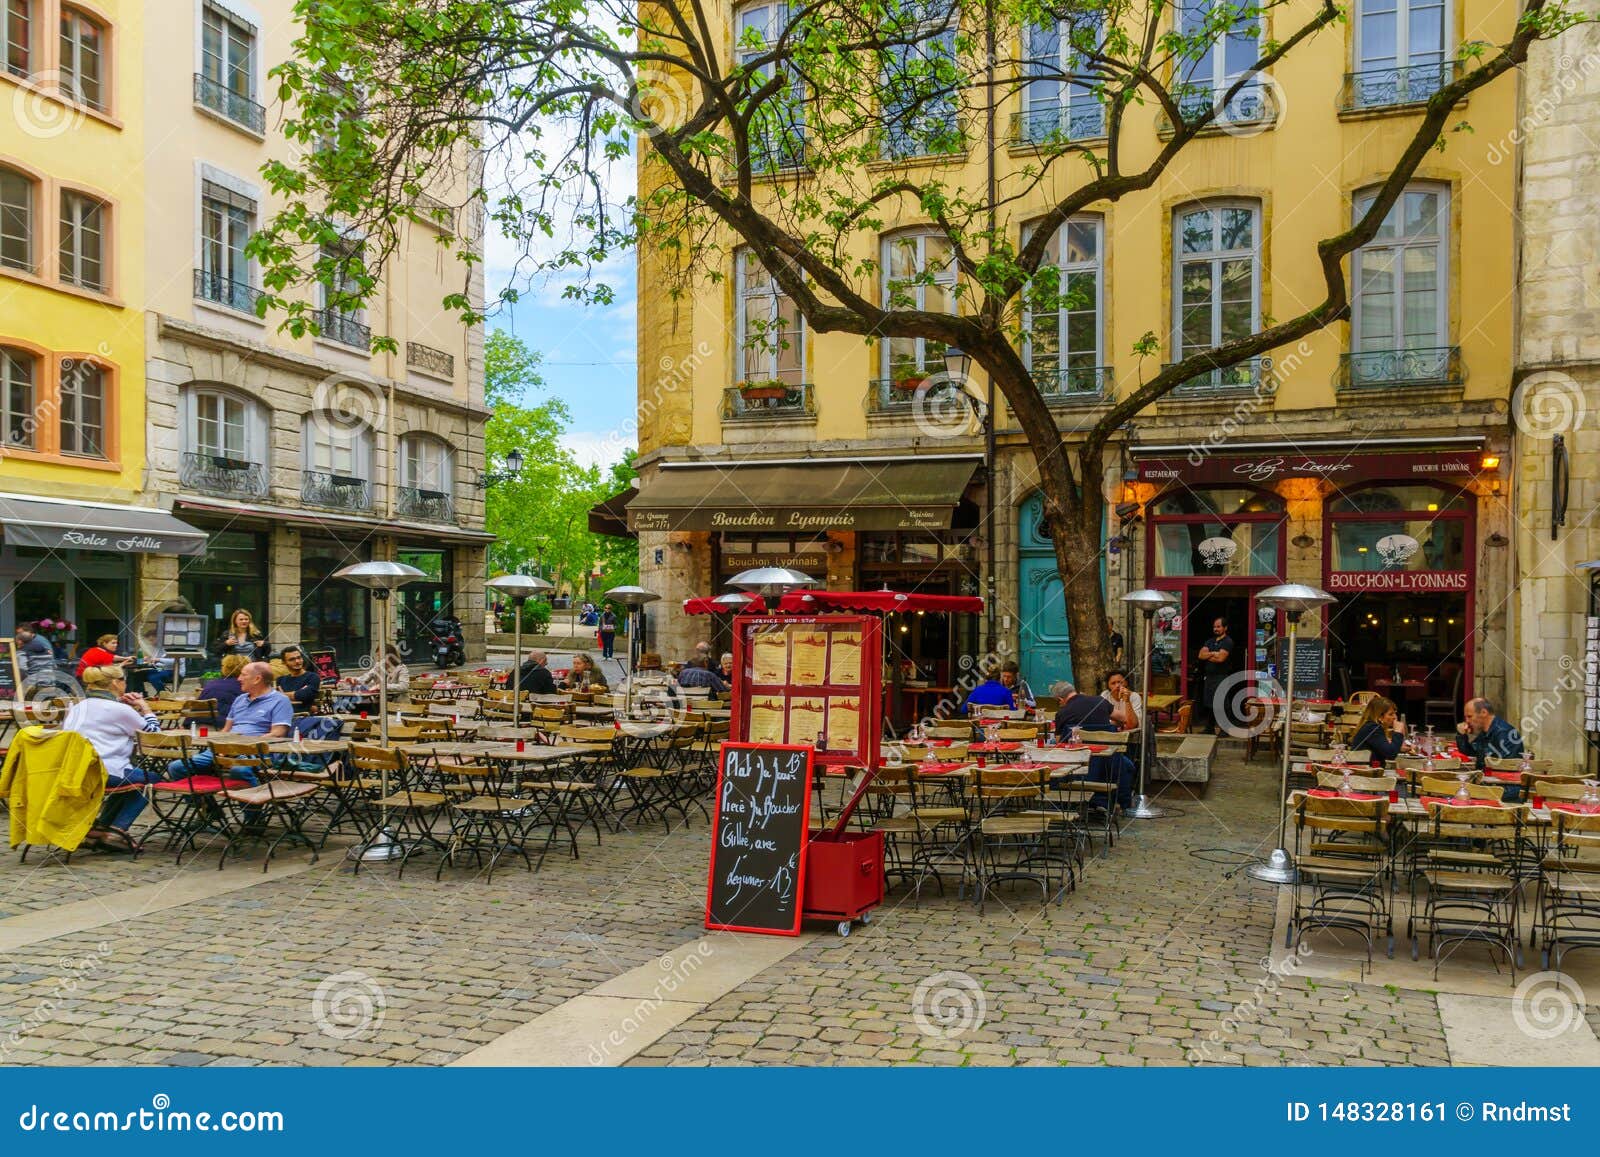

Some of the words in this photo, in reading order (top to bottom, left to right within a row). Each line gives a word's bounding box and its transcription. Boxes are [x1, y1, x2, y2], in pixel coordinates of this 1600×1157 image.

[1144, 470, 1179, 478] RESTAURANT
[1233, 458, 1285, 481] Chez
[1412, 464, 1439, 472] BOUCHON
[1441, 463, 1470, 472] LYONNAIS
[711, 511, 775, 526] Bouchon
[786, 511, 855, 529] Lyonnais
[62, 531, 108, 545] Dolce
[116, 536, 162, 551] Follia
[728, 557, 770, 567] Bouchon
[775, 556, 819, 568] Lyonnais
[726, 751, 752, 777] Plat
